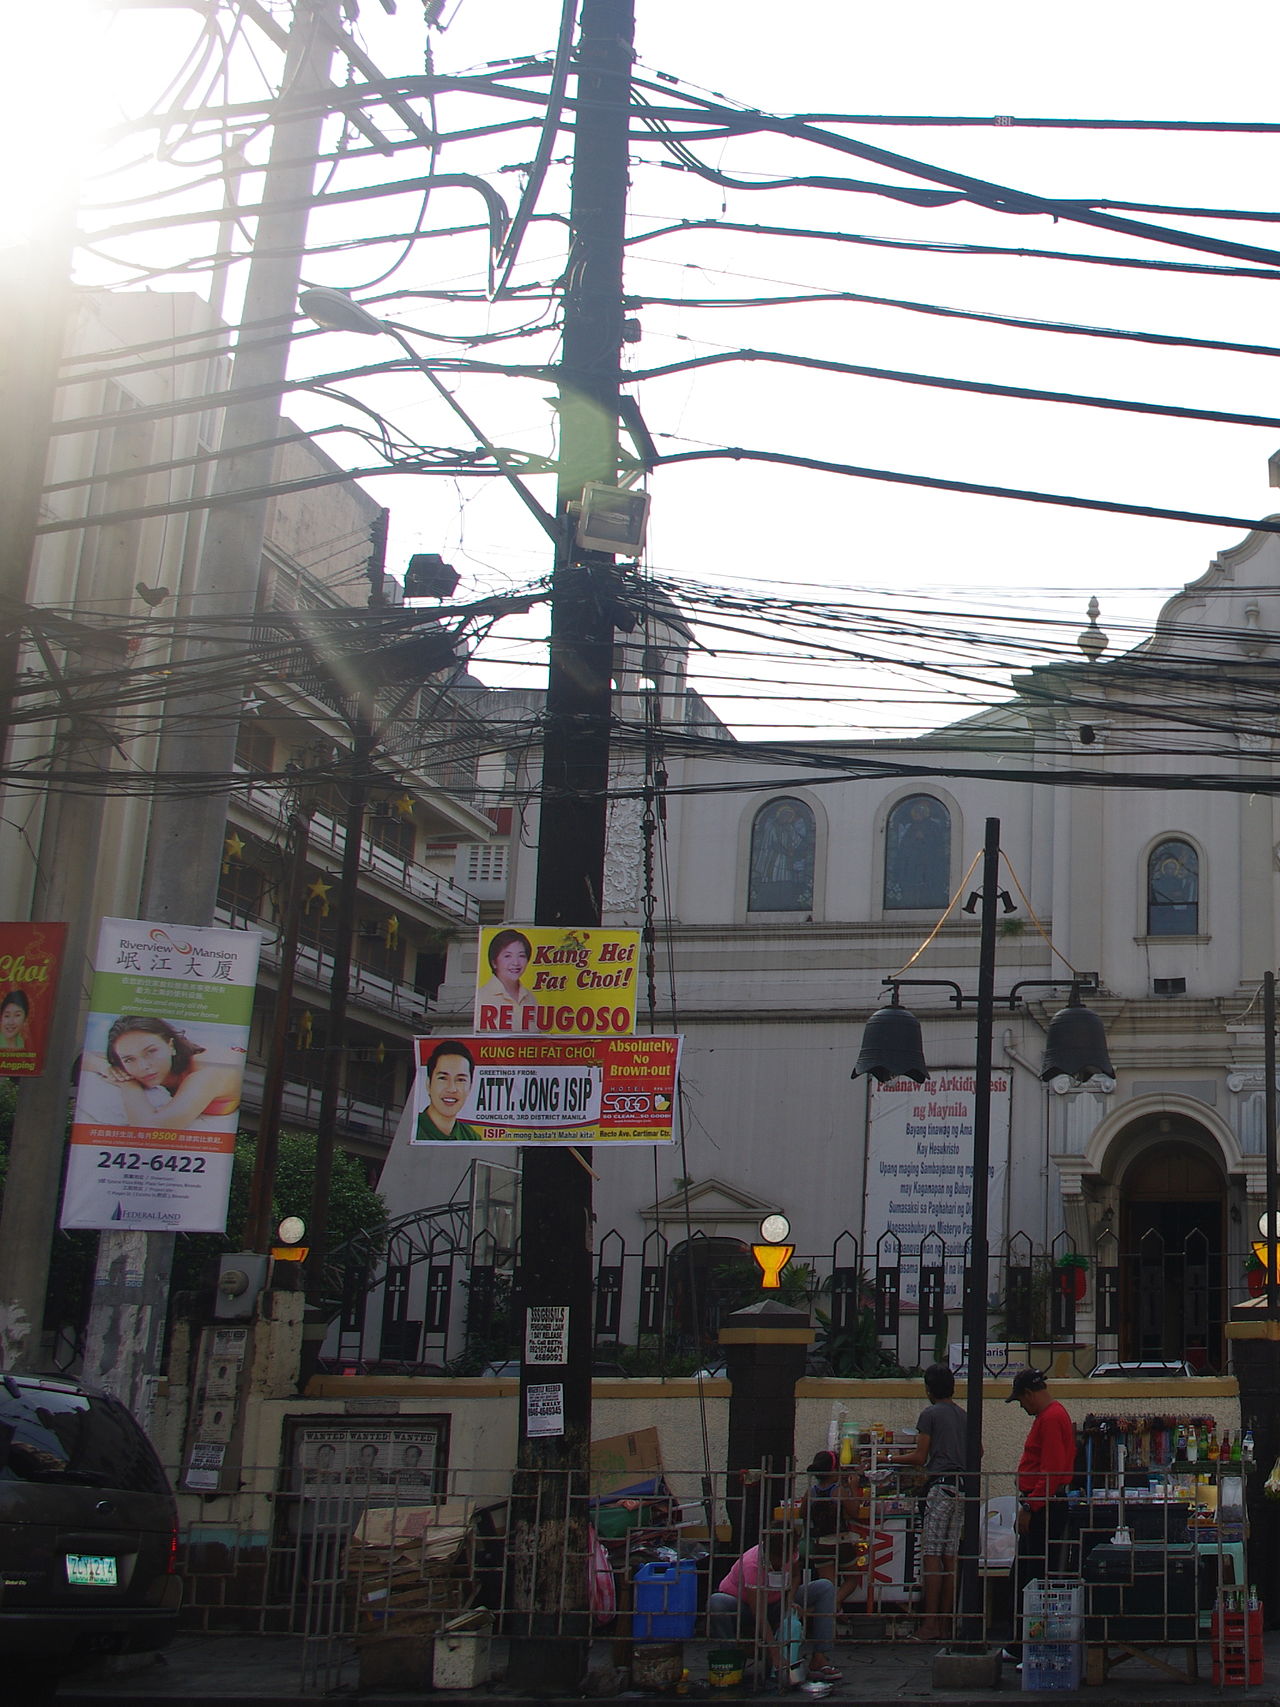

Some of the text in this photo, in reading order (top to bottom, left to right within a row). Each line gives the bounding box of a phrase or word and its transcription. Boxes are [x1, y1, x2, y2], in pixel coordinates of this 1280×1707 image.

[120, 939, 238, 960] Riverview Mansion
[533, 943, 635, 969] Kung Hei
[117, 951, 235, 981] 岷江大厦
[533, 967, 634, 990] Fat Choi!
[480, 1005, 631, 1032] RE FUGOSO
[480, 1046, 595, 1059] KUNG HEI FAT CHOI
[608, 1040, 674, 1053] Absolutely,
[633, 1054, 649, 1064] No
[610, 1065, 671, 1076] Brown-out
[476, 1077, 592, 1112] ATTY. JONG ISIP
[603, 1092, 651, 1113] SOGO
[913, 1102, 968, 1120] ng Maynila
[906, 1123, 927, 1137] Bayang
[928, 1123, 950, 1137] tinawag
[960, 1123, 973, 1135] Ama
[917, 1142, 960, 1157] Kay Hesukristo
[97, 1151, 206, 1174] 242-6422
[880, 1161, 897, 1177] Upang
[158, 1210, 181, 1220] LAND
